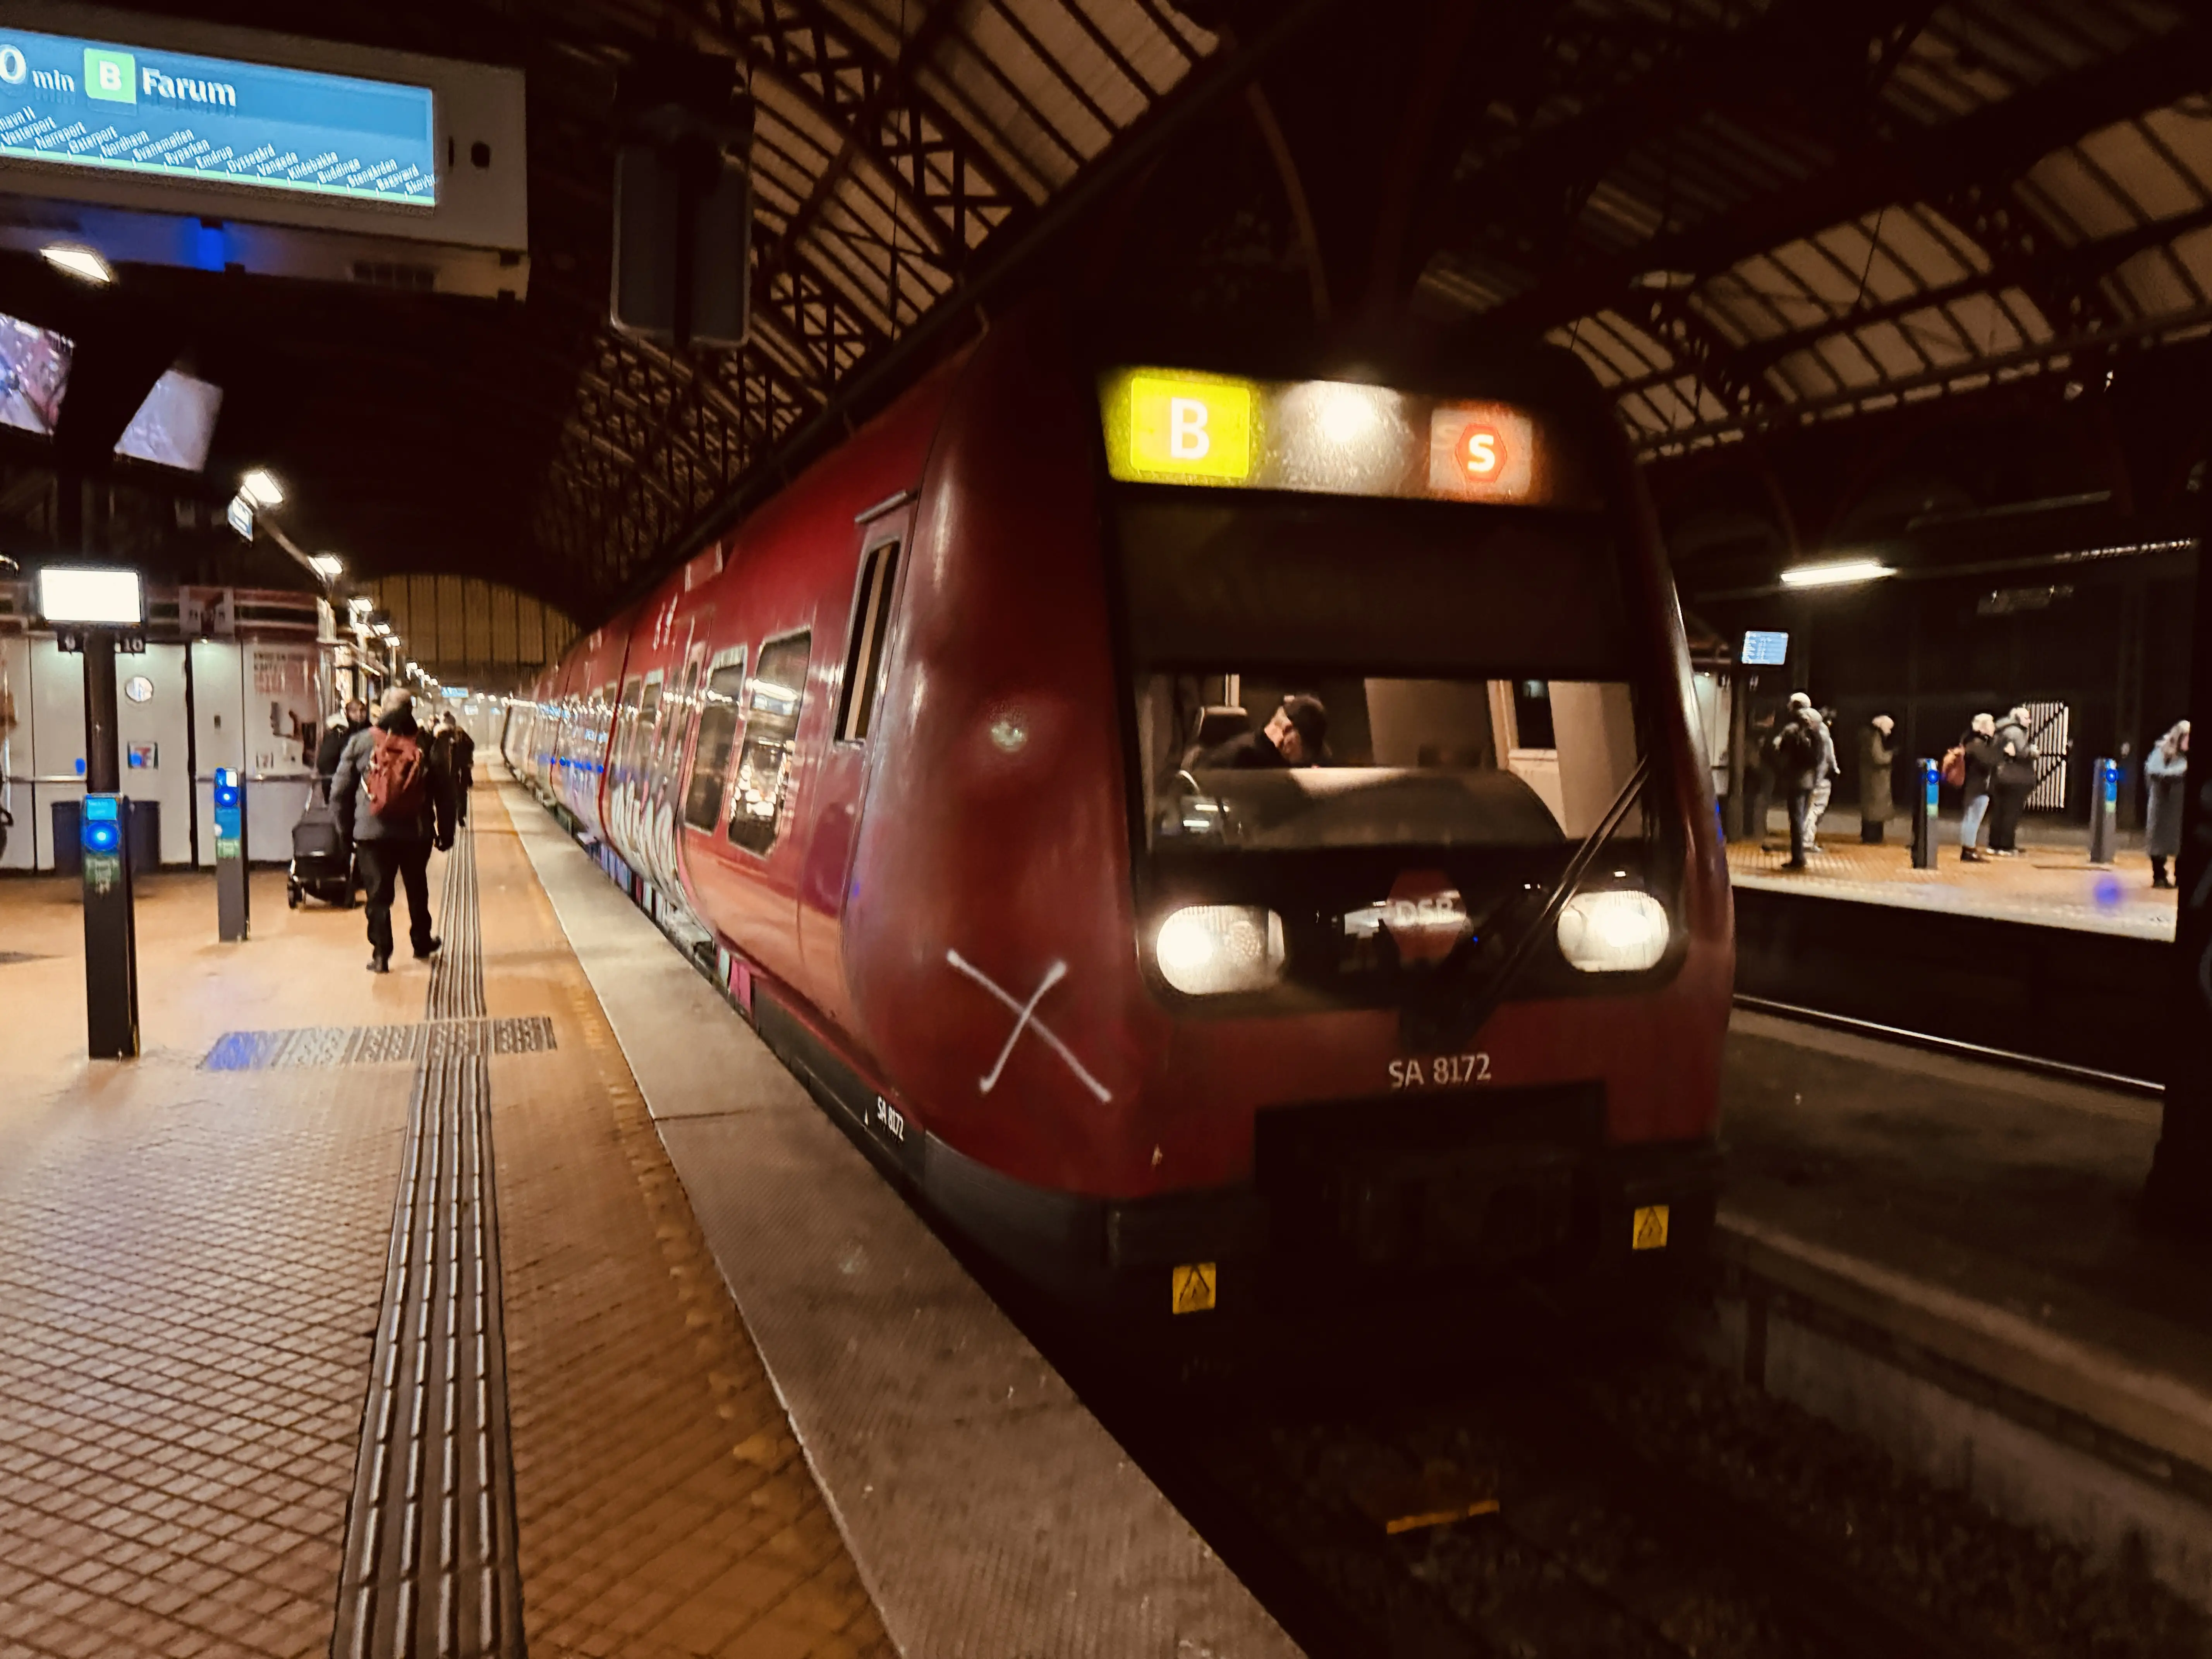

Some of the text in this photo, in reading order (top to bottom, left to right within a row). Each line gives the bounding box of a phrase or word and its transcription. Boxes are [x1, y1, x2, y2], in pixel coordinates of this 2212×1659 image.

[32, 70, 75, 92] min
[99, 60, 122, 91] B
[142, 67, 236, 107] Farum
[0, 116, 57, 146] Vesterport
[100, 131, 150, 158] Nordhavn
[164, 139, 211, 165] Ryparken
[195, 146, 234, 169] Emdrup
[257, 152, 298, 176] Vangede
[287, 151, 338, 180] Kildebakke
[1171, 397, 1210, 459] B
[1467, 433, 1495, 472] S
[124, 637, 143, 652] 10
[1394, 897, 1455, 926] DSB
[1388, 1051, 1491, 1089] SA 8172
[877, 1096, 887, 1126] SA
